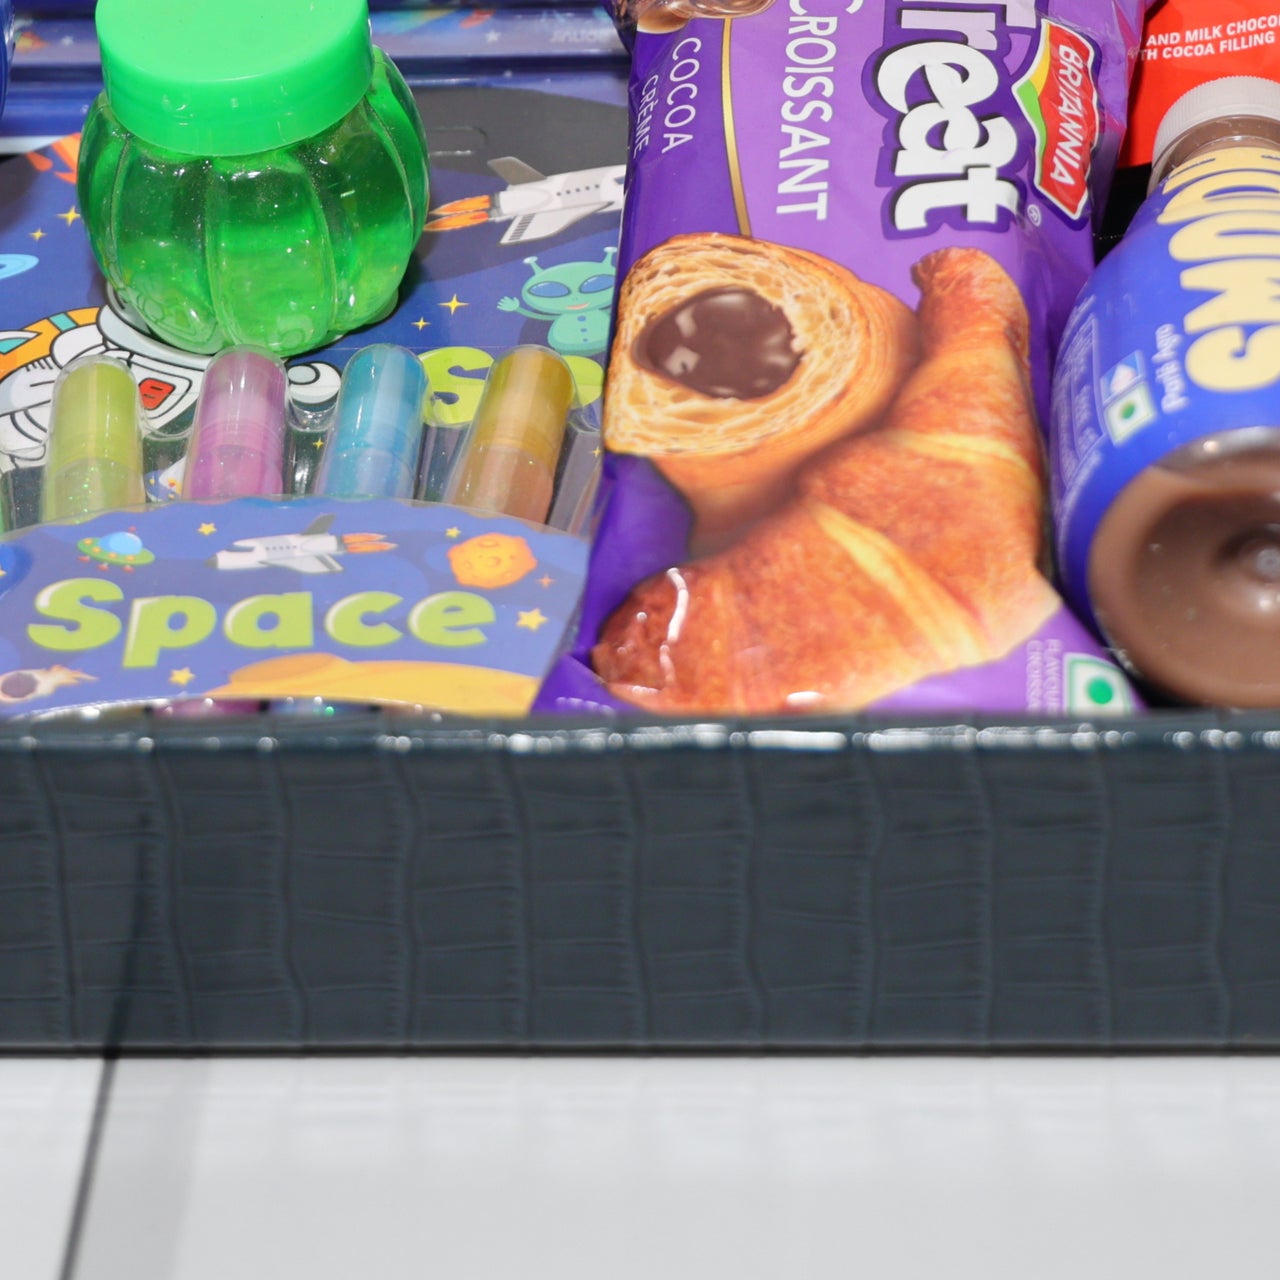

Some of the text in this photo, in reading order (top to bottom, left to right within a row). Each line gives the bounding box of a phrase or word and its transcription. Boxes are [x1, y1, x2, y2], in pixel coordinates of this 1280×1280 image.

[1146, 32, 1180, 47] AND
[1185, 25, 1222, 44] MILK
[1162, 42, 1215, 59] COCOA
[1219, 31, 1275, 53] FILLING
[661, 37, 702, 154] COCOA
[1050, 43, 1086, 187] BRITANNIA
[28, 577, 496, 667] Space
